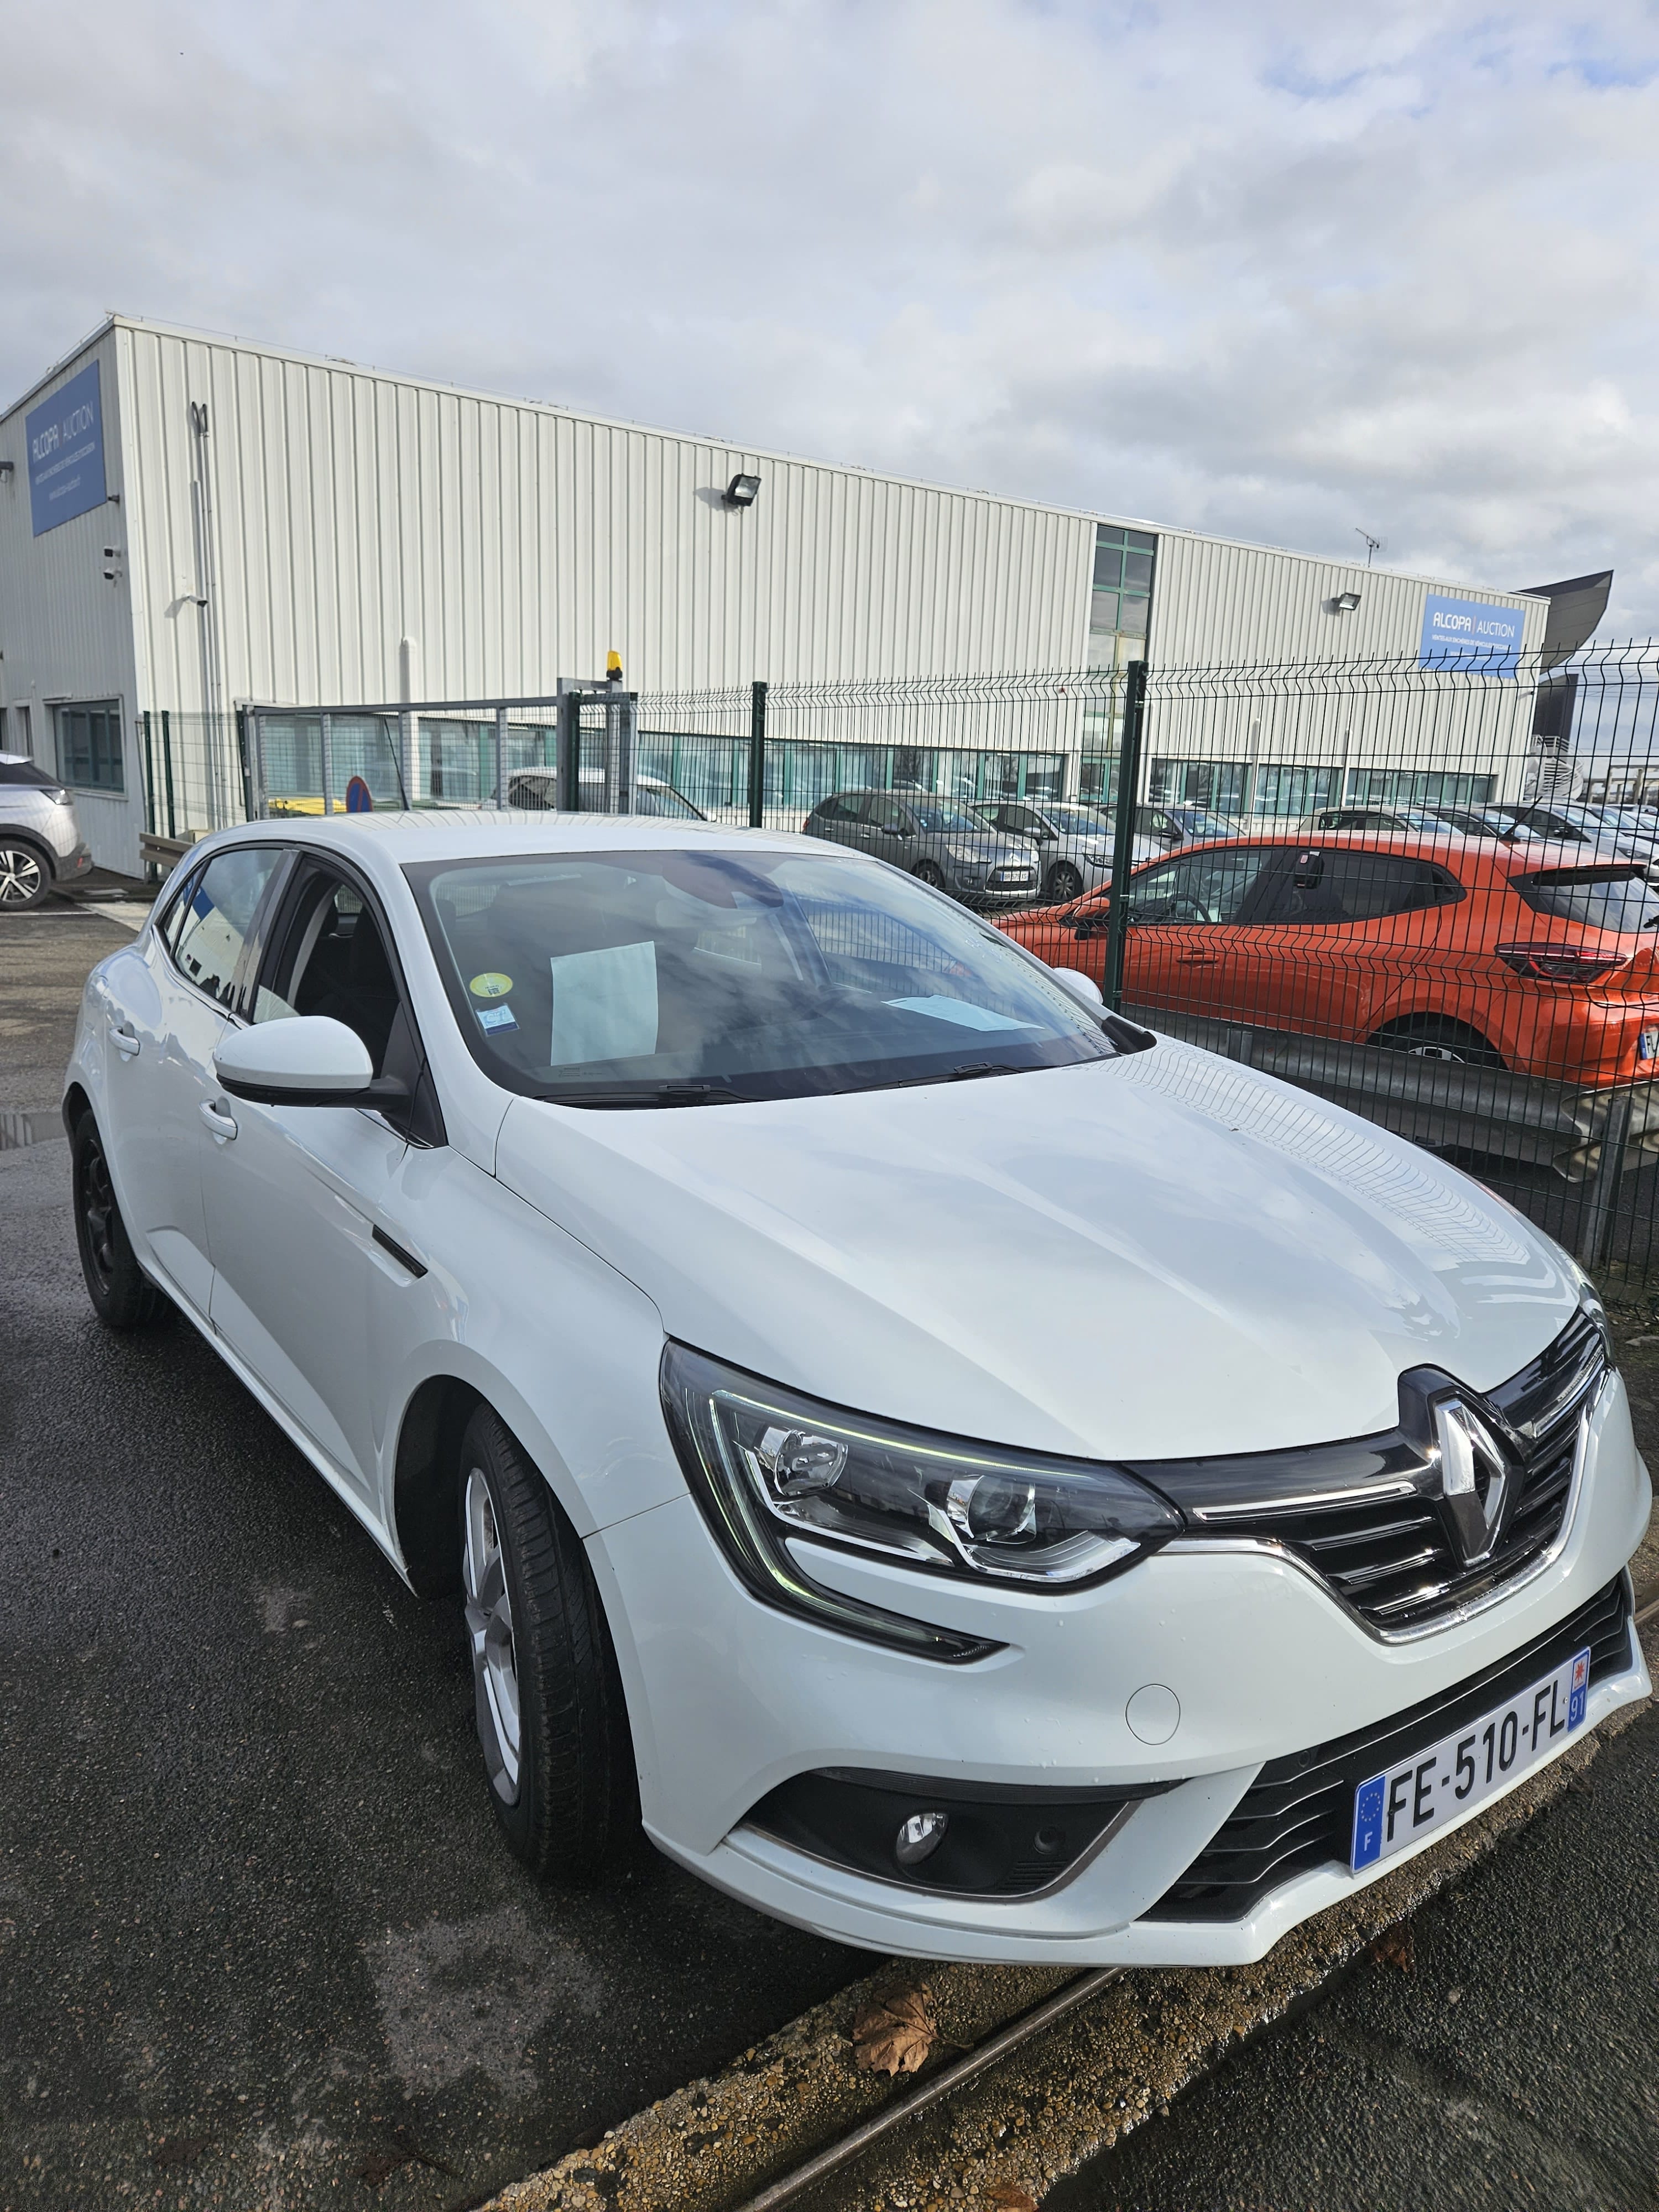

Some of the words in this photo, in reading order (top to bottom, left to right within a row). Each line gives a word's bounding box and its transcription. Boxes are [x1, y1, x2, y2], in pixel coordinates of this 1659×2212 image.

[32, 424, 59, 463] ALCOPA
[62, 401, 94, 444] AUCTION
[1433, 612, 1472, 632] ALCOPA
[1477, 620, 1515, 637] AUCTION
[1571, 1691, 1584, 1722] 91
[1387, 1679, 1565, 1842] FE-510-FL
[1364, 1831, 1373, 1851] F
